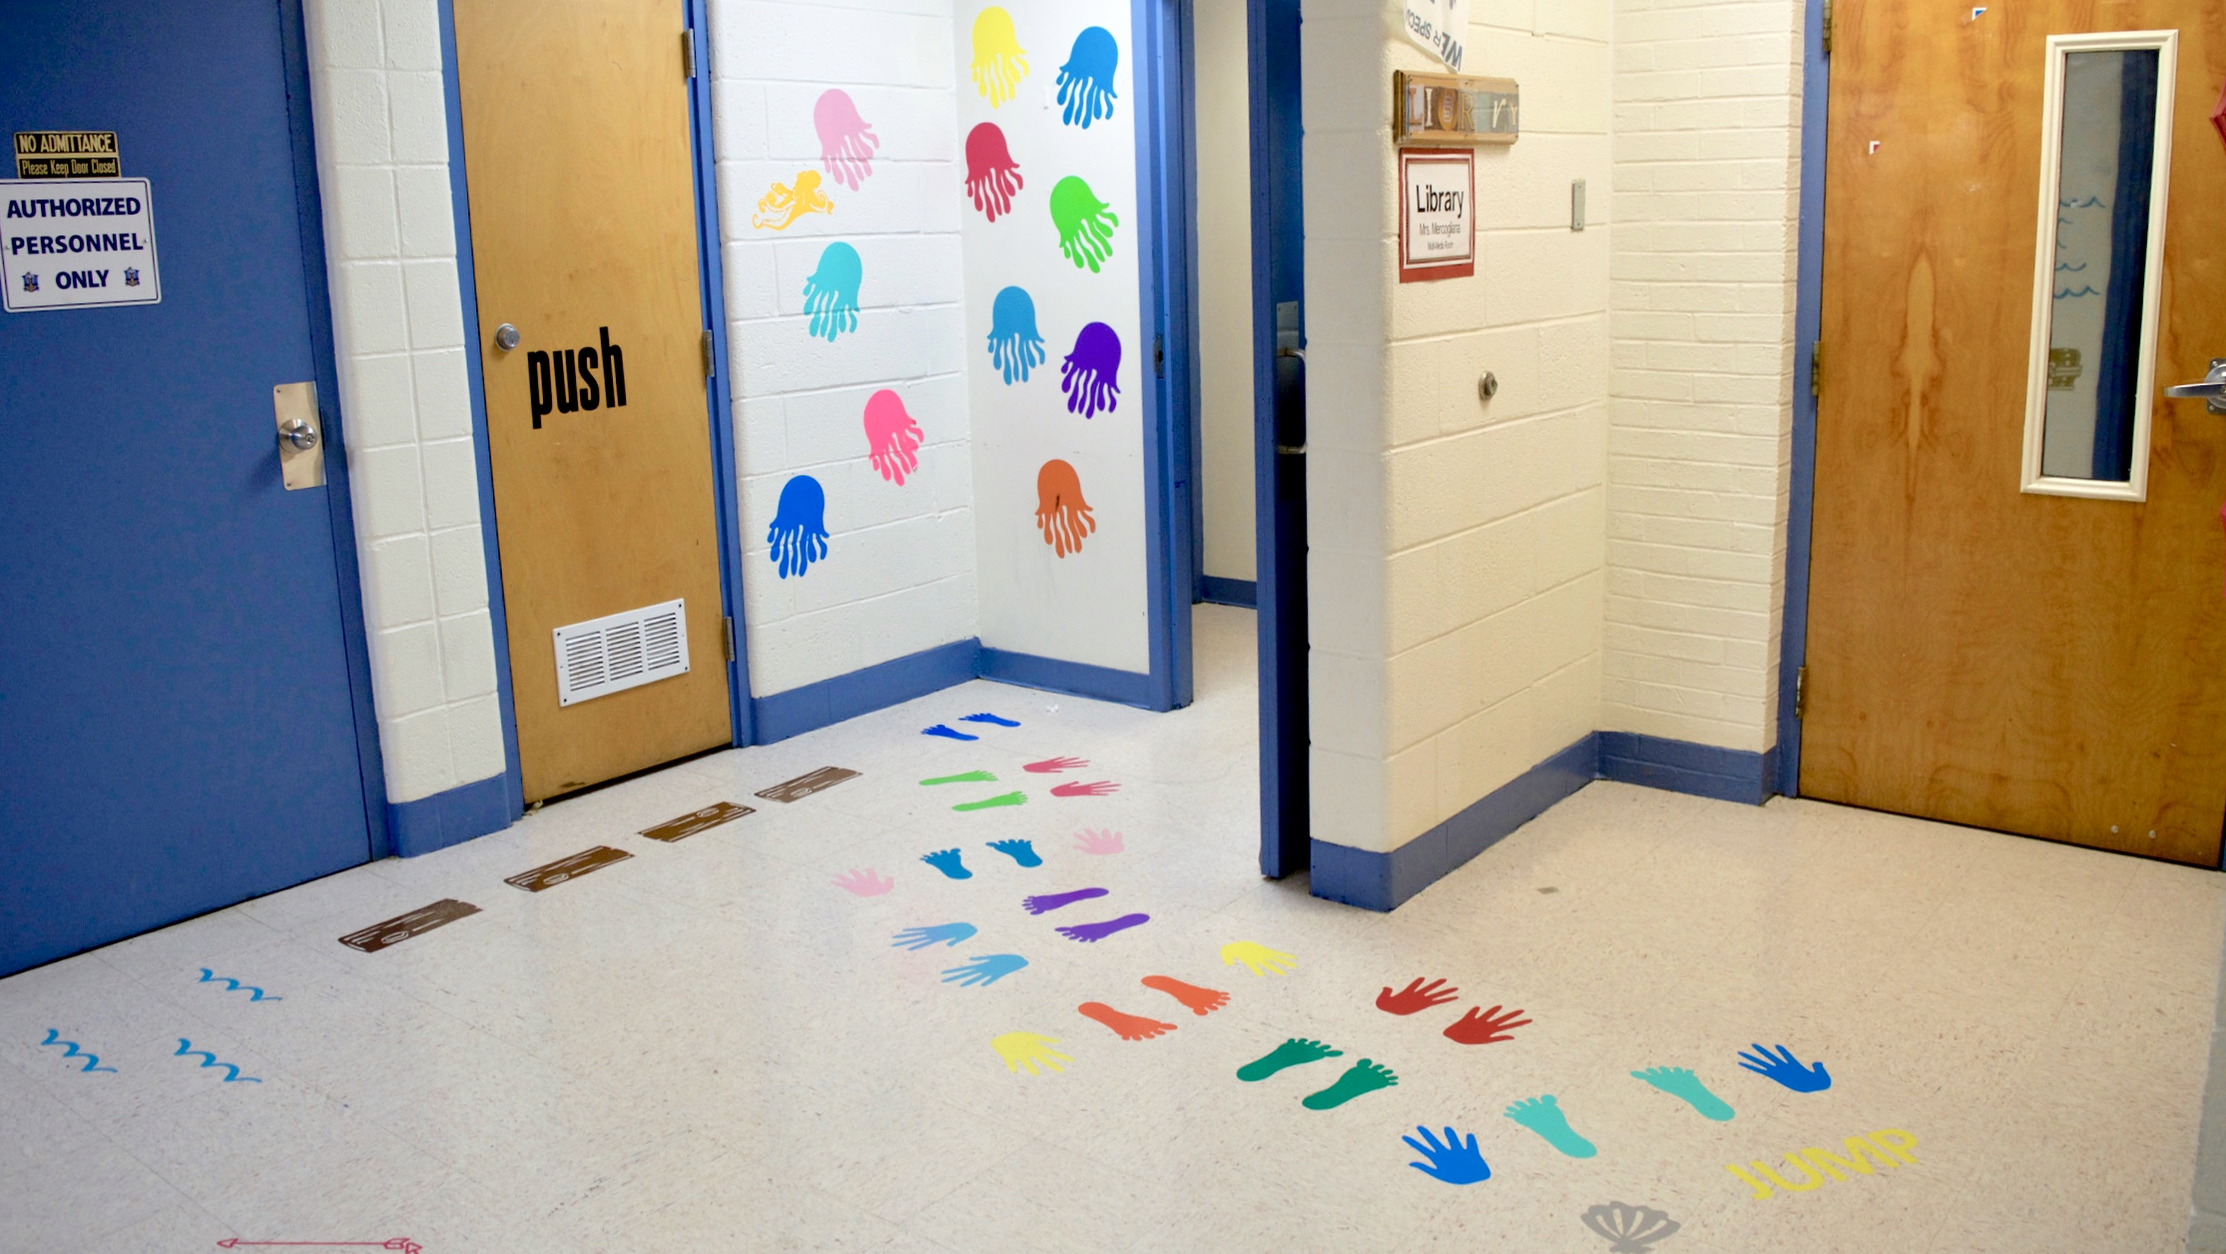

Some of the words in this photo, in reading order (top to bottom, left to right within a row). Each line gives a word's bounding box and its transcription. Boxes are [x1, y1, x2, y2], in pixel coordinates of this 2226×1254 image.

[18, 134, 37, 153] NO
[40, 133, 114, 153] ADMITTANCE
[21, 159, 49, 176] Please
[50, 159, 70, 178] Keep
[71, 158, 89, 175] Door
[90, 158, 117, 174] Closed
[7, 197, 141, 219] AUTHORIZED
[1416, 184, 1465, 219] Library
[11, 232, 145, 255] PERSONNEL
[55, 269, 110, 290] ONLY
[527, 326, 627, 429] push
[1724, 1129, 1918, 1200] JUMP
